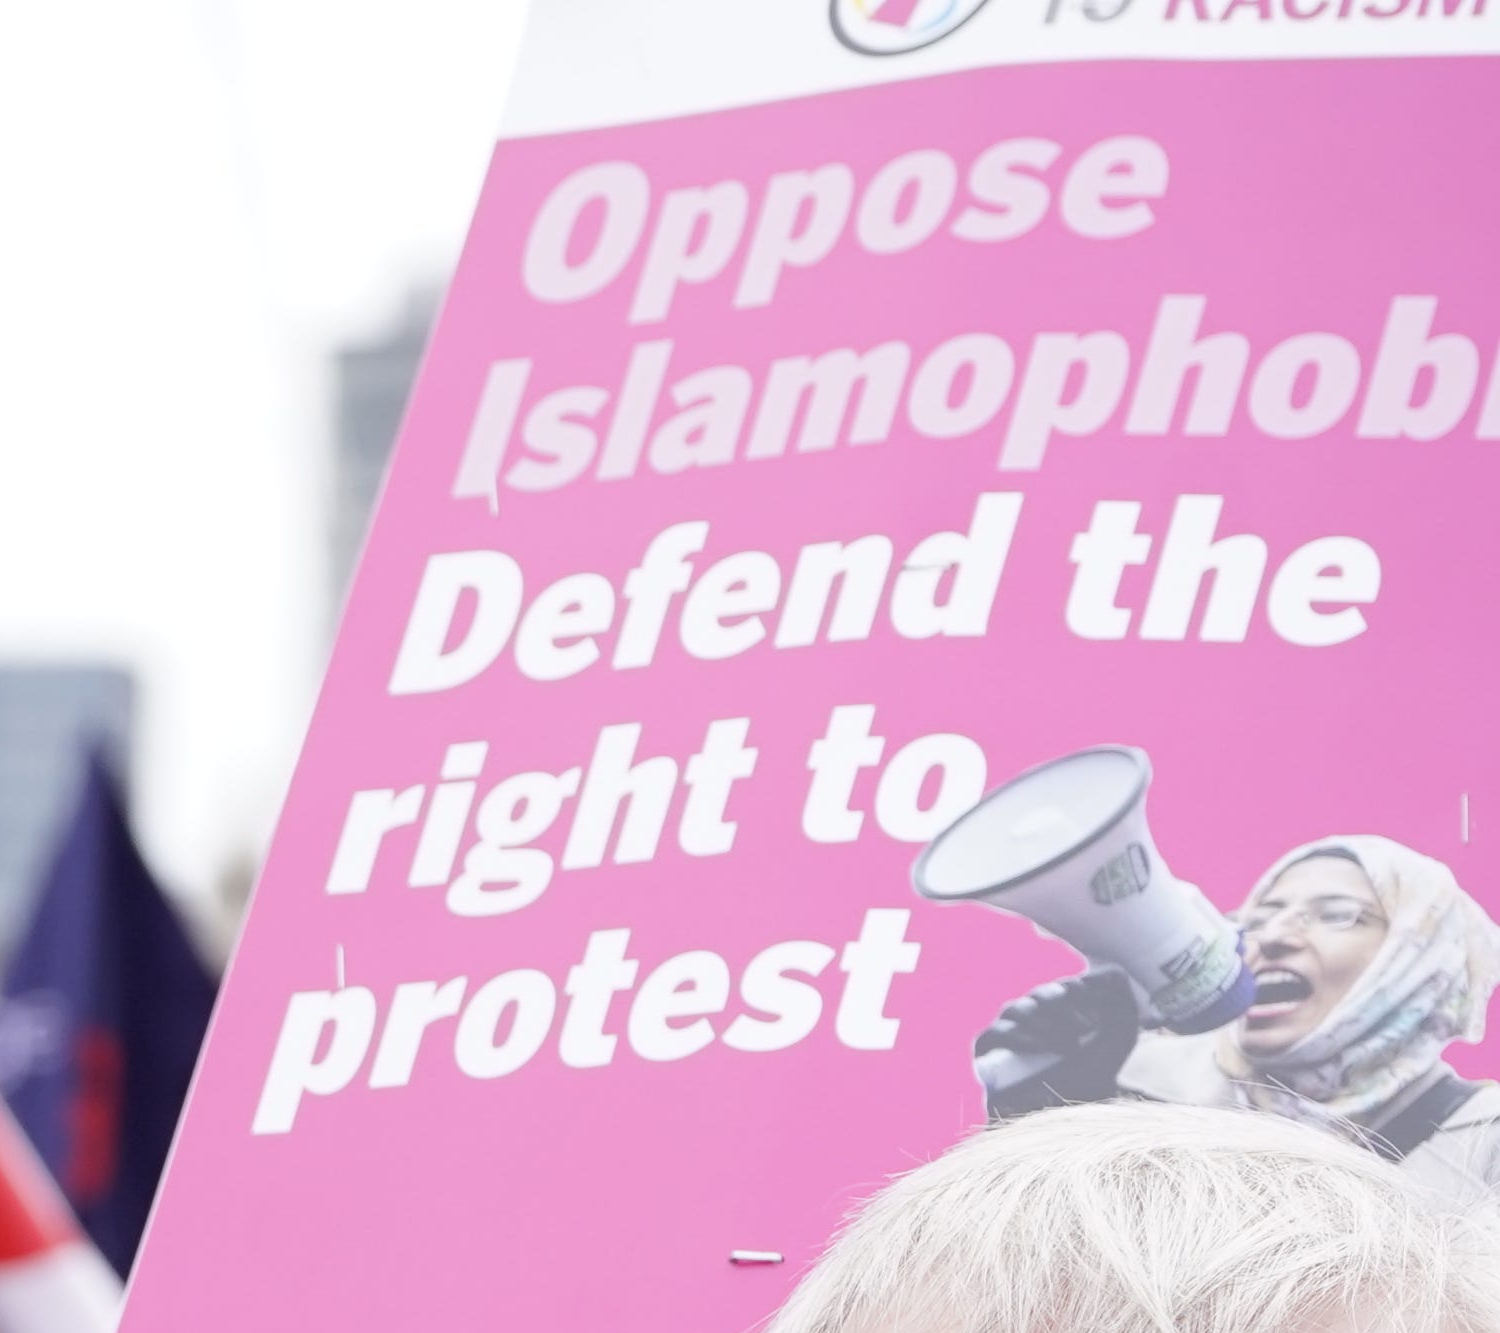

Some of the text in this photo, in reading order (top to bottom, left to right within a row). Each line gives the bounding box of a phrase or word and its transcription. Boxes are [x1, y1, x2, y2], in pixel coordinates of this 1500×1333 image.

[520, 134, 1169, 325] Oppose
[451, 293, 1500, 500] Islamophob
[388, 490, 1381, 695] Defend the
[325, 704, 987, 917] right to
[251, 908, 921, 1134] protest
